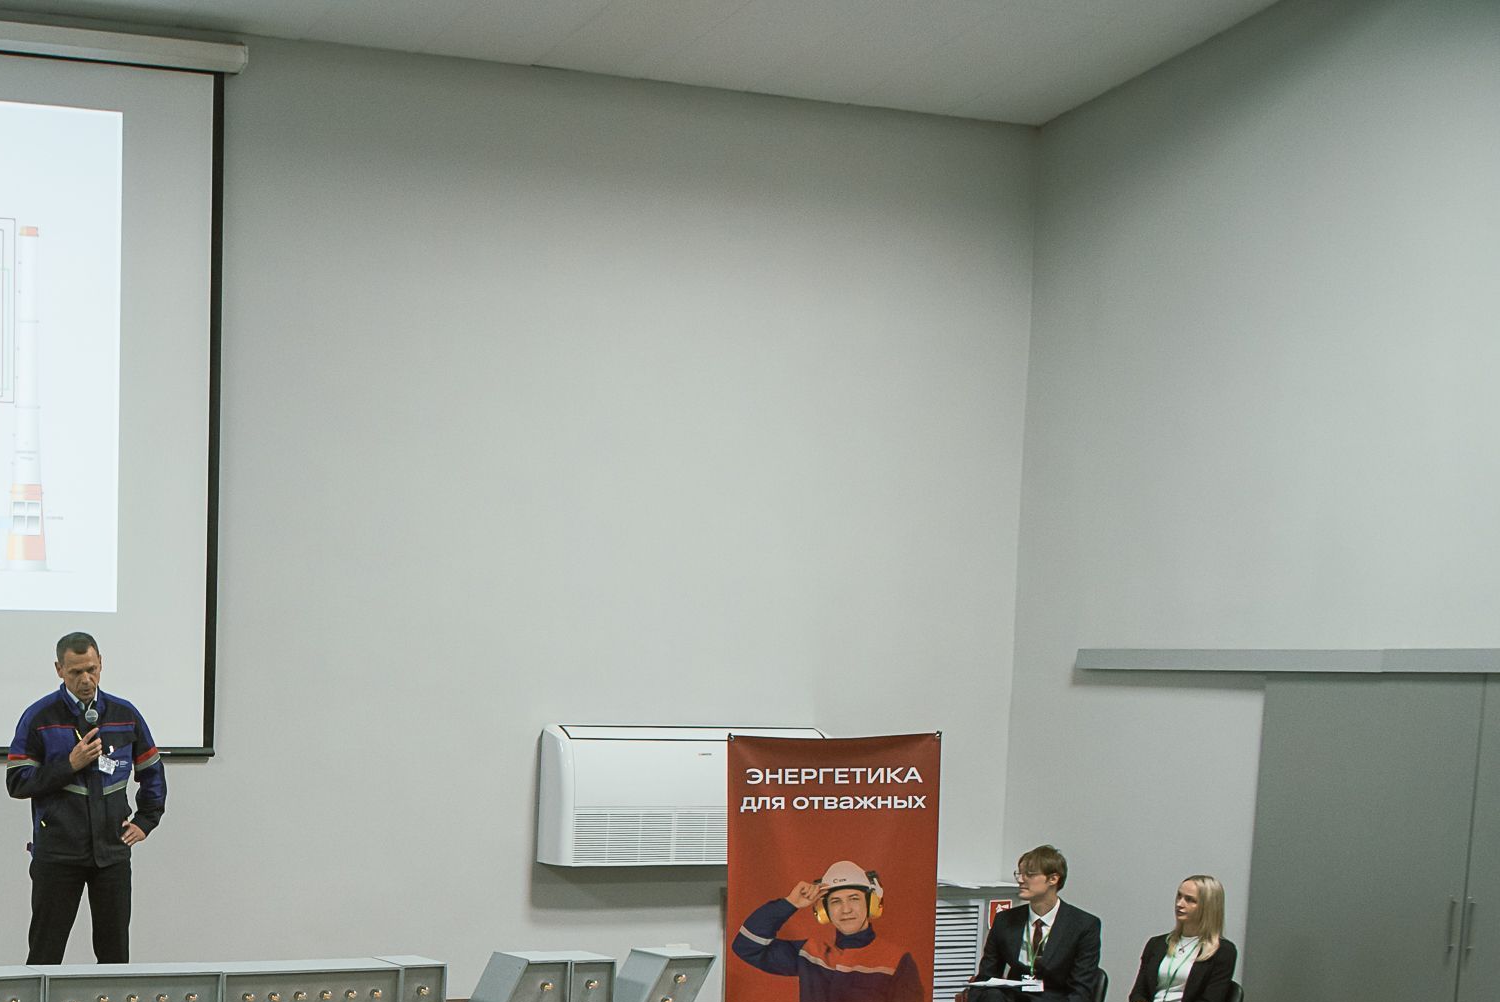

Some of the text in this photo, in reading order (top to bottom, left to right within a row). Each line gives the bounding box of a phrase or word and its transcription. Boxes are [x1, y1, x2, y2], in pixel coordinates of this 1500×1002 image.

[746, 767, 923, 785] ЭНЕРГЕТИКА
[740, 794, 926, 812] для отважных
